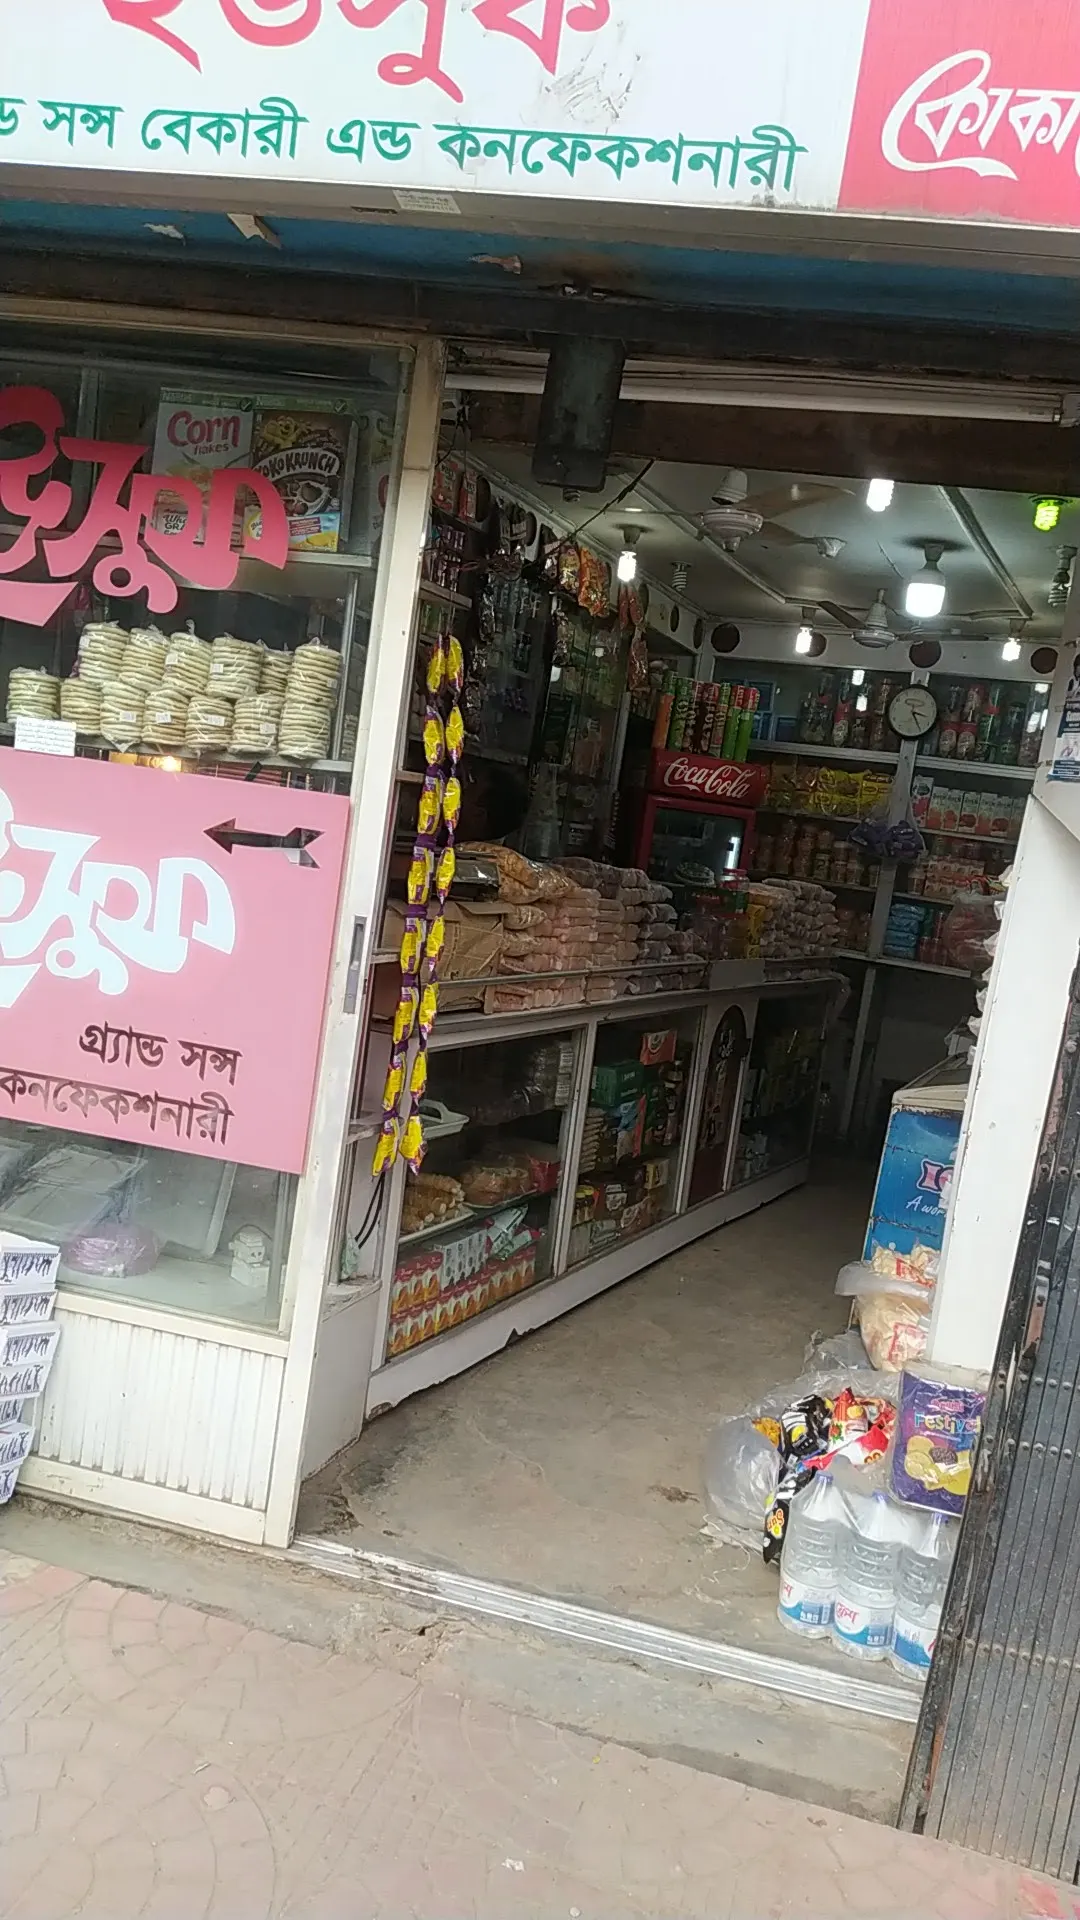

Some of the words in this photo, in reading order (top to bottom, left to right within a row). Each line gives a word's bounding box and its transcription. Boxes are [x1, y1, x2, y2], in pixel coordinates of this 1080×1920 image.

[37, 99, 125, 150] সন্স
[141, 97, 309, 160] বেকারী
[326, 119, 421, 164] এন্ড
[433, 123, 809, 192] কনফেকশনারী
[166, 410, 241, 448] Corn
[177, 1039, 243, 1086] সন্স
[905, 1195, 923, 1211] A
